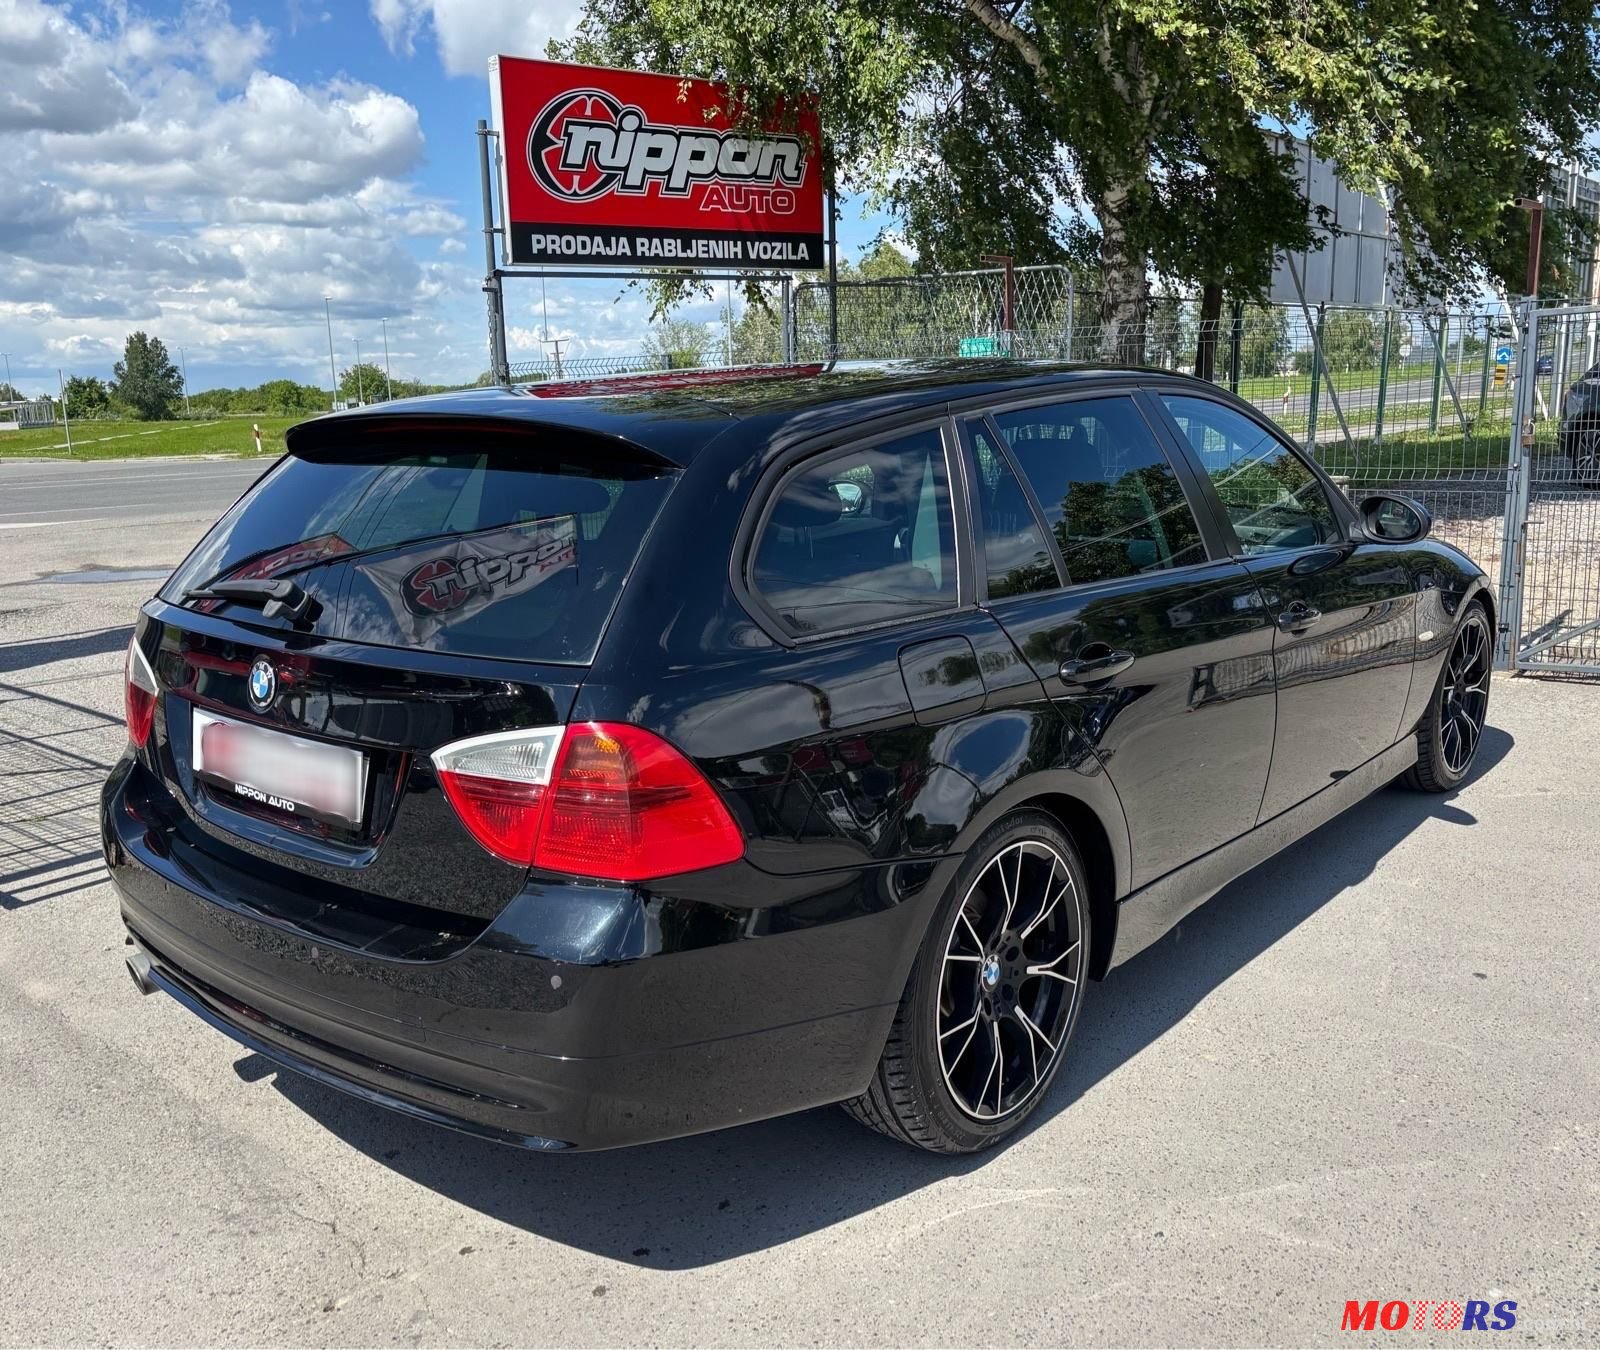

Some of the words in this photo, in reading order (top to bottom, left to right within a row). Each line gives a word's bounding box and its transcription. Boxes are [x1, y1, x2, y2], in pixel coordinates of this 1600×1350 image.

[562, 106, 806, 196] nippon
[700, 185, 796, 214] AUTO
[531, 234, 631, 257] PRODAJA
[636, 237, 742, 259] RABLJENIH
[747, 241, 809, 260] VOZILA
[235, 784, 267, 803] NIPPON
[268, 796, 295, 811] AUTO
